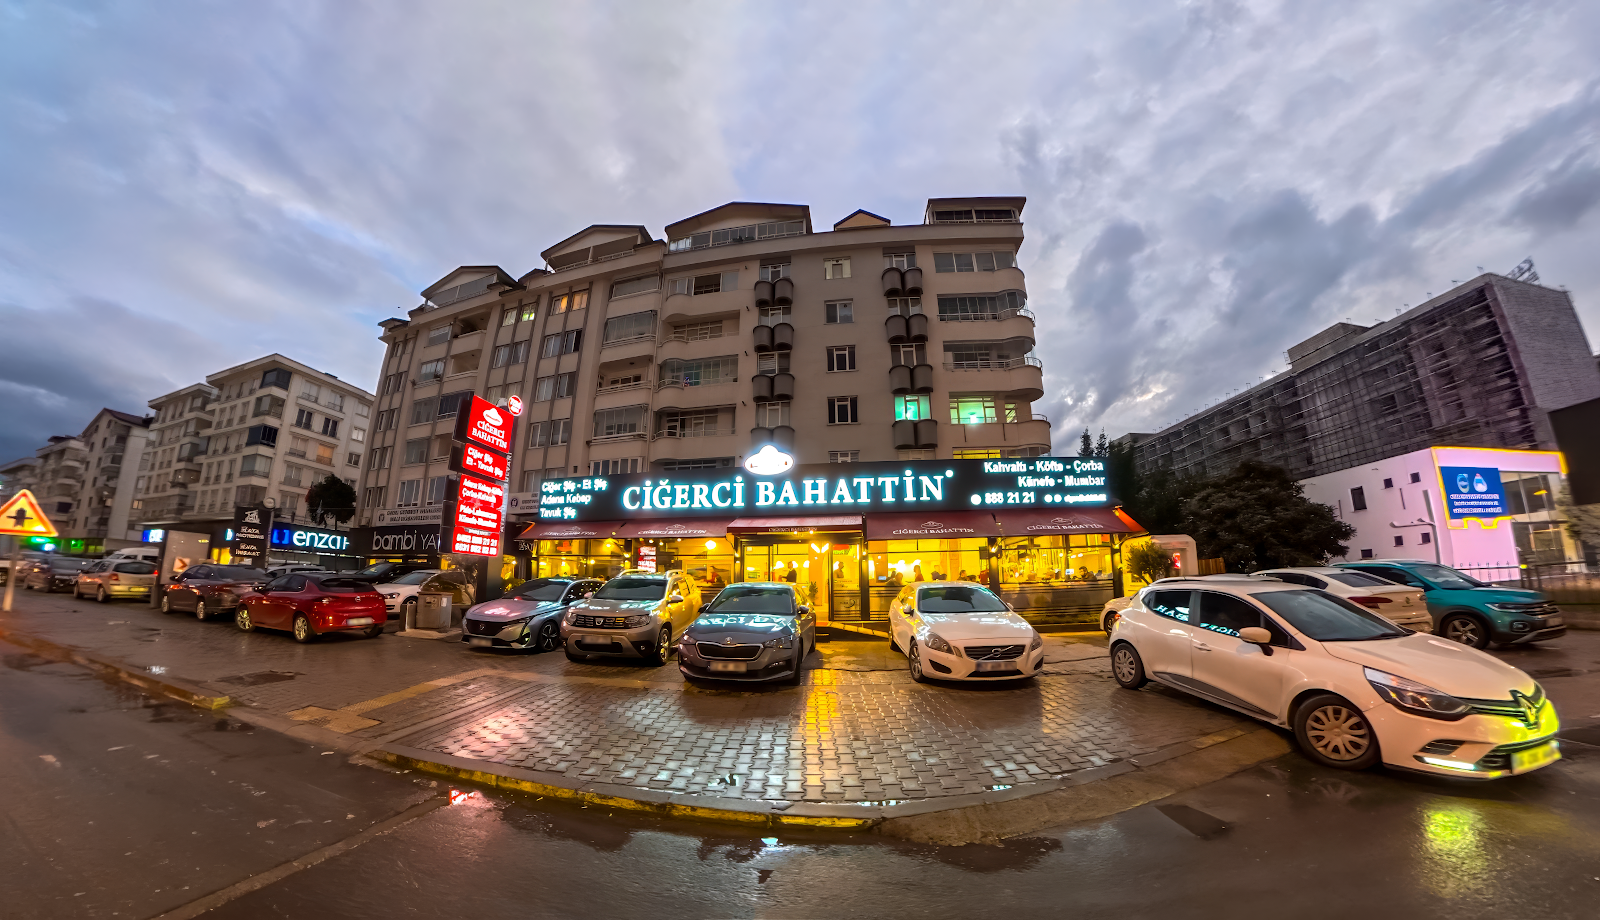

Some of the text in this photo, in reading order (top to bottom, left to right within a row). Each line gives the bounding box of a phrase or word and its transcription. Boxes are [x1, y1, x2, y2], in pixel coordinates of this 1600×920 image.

[1073, 460, 1104, 473] Çorba
[1017, 475, 1055, 488] Künefe
[1064, 475, 1105, 487] Mumbar
[622, 469, 945, 510] CİĞERCİ BAHATTİN
[540, 494, 565, 505] Adana
[566, 493, 592, 505] Kebap
[1007, 492, 1020, 503] 21
[1022, 491, 1035, 503] 21
[540, 507, 562, 518] Tavuk
[292, 530, 341, 549] enza
[372, 529, 417, 551] bambi
